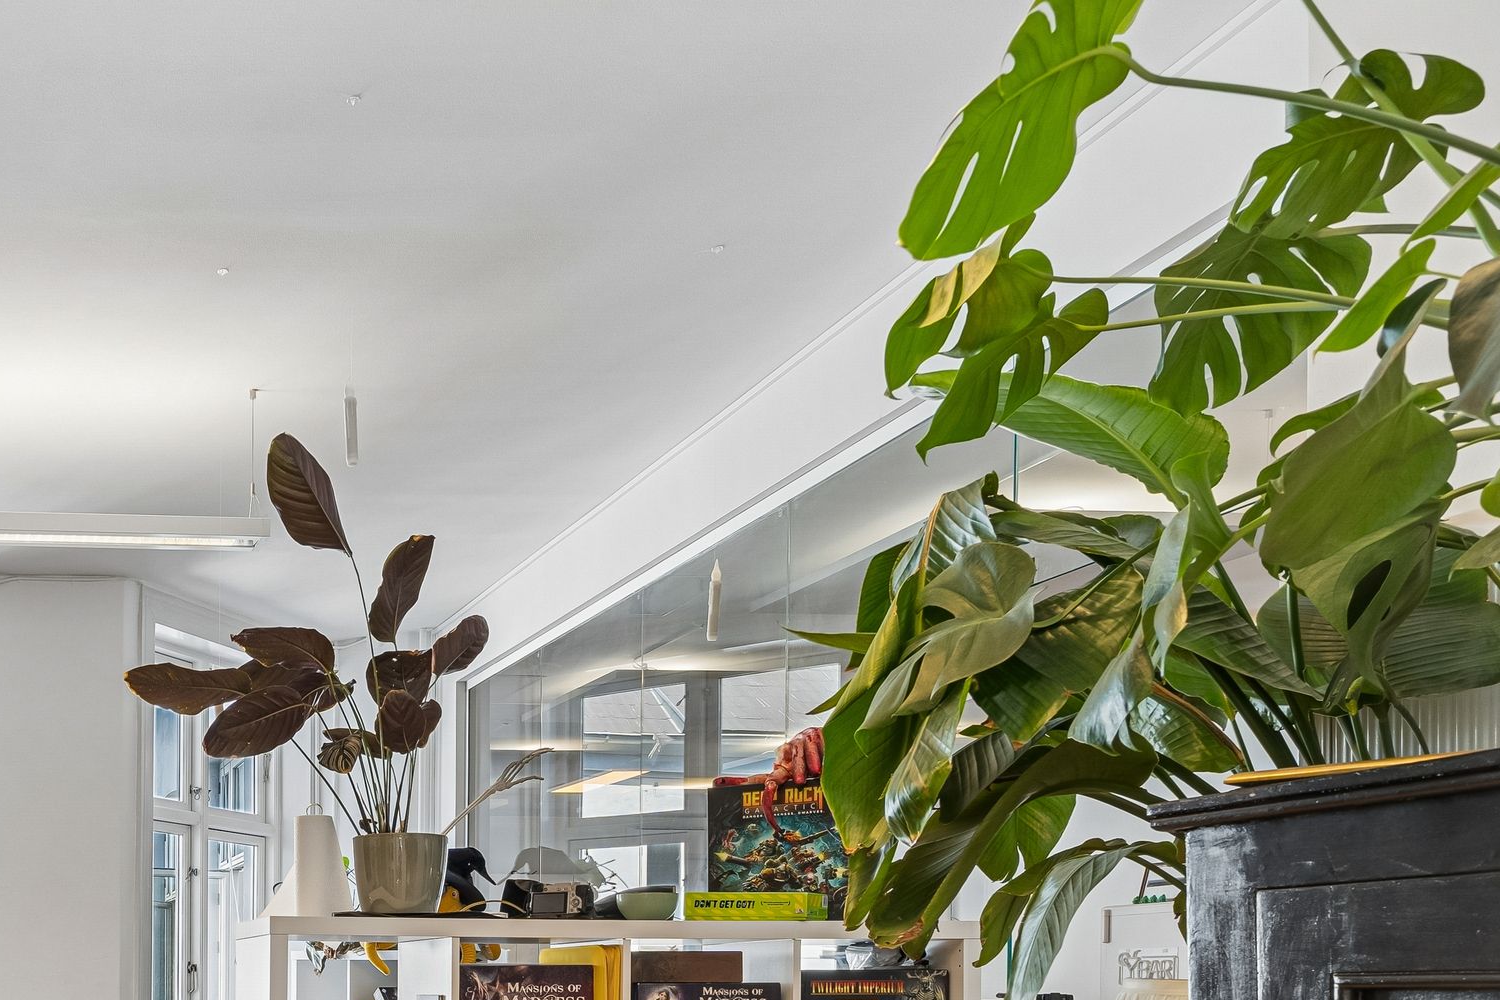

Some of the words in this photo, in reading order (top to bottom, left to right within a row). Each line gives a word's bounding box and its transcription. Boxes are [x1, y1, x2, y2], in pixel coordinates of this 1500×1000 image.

[744, 802, 816, 815] GAACTIC
[694, 899, 718, 908] DON'T
[720, 900, 735, 909] GET
[736, 900, 756, 909] GOT!
[507, 982, 564, 995] MANSIONS
[567, 984, 582, 993] OF
[702, 986, 749, 997] MANSIONS
[752, 988, 764, 996] OF
[811, 980, 856, 994] TWILIGHT
[858, 980, 905, 994] IMPERIUM
